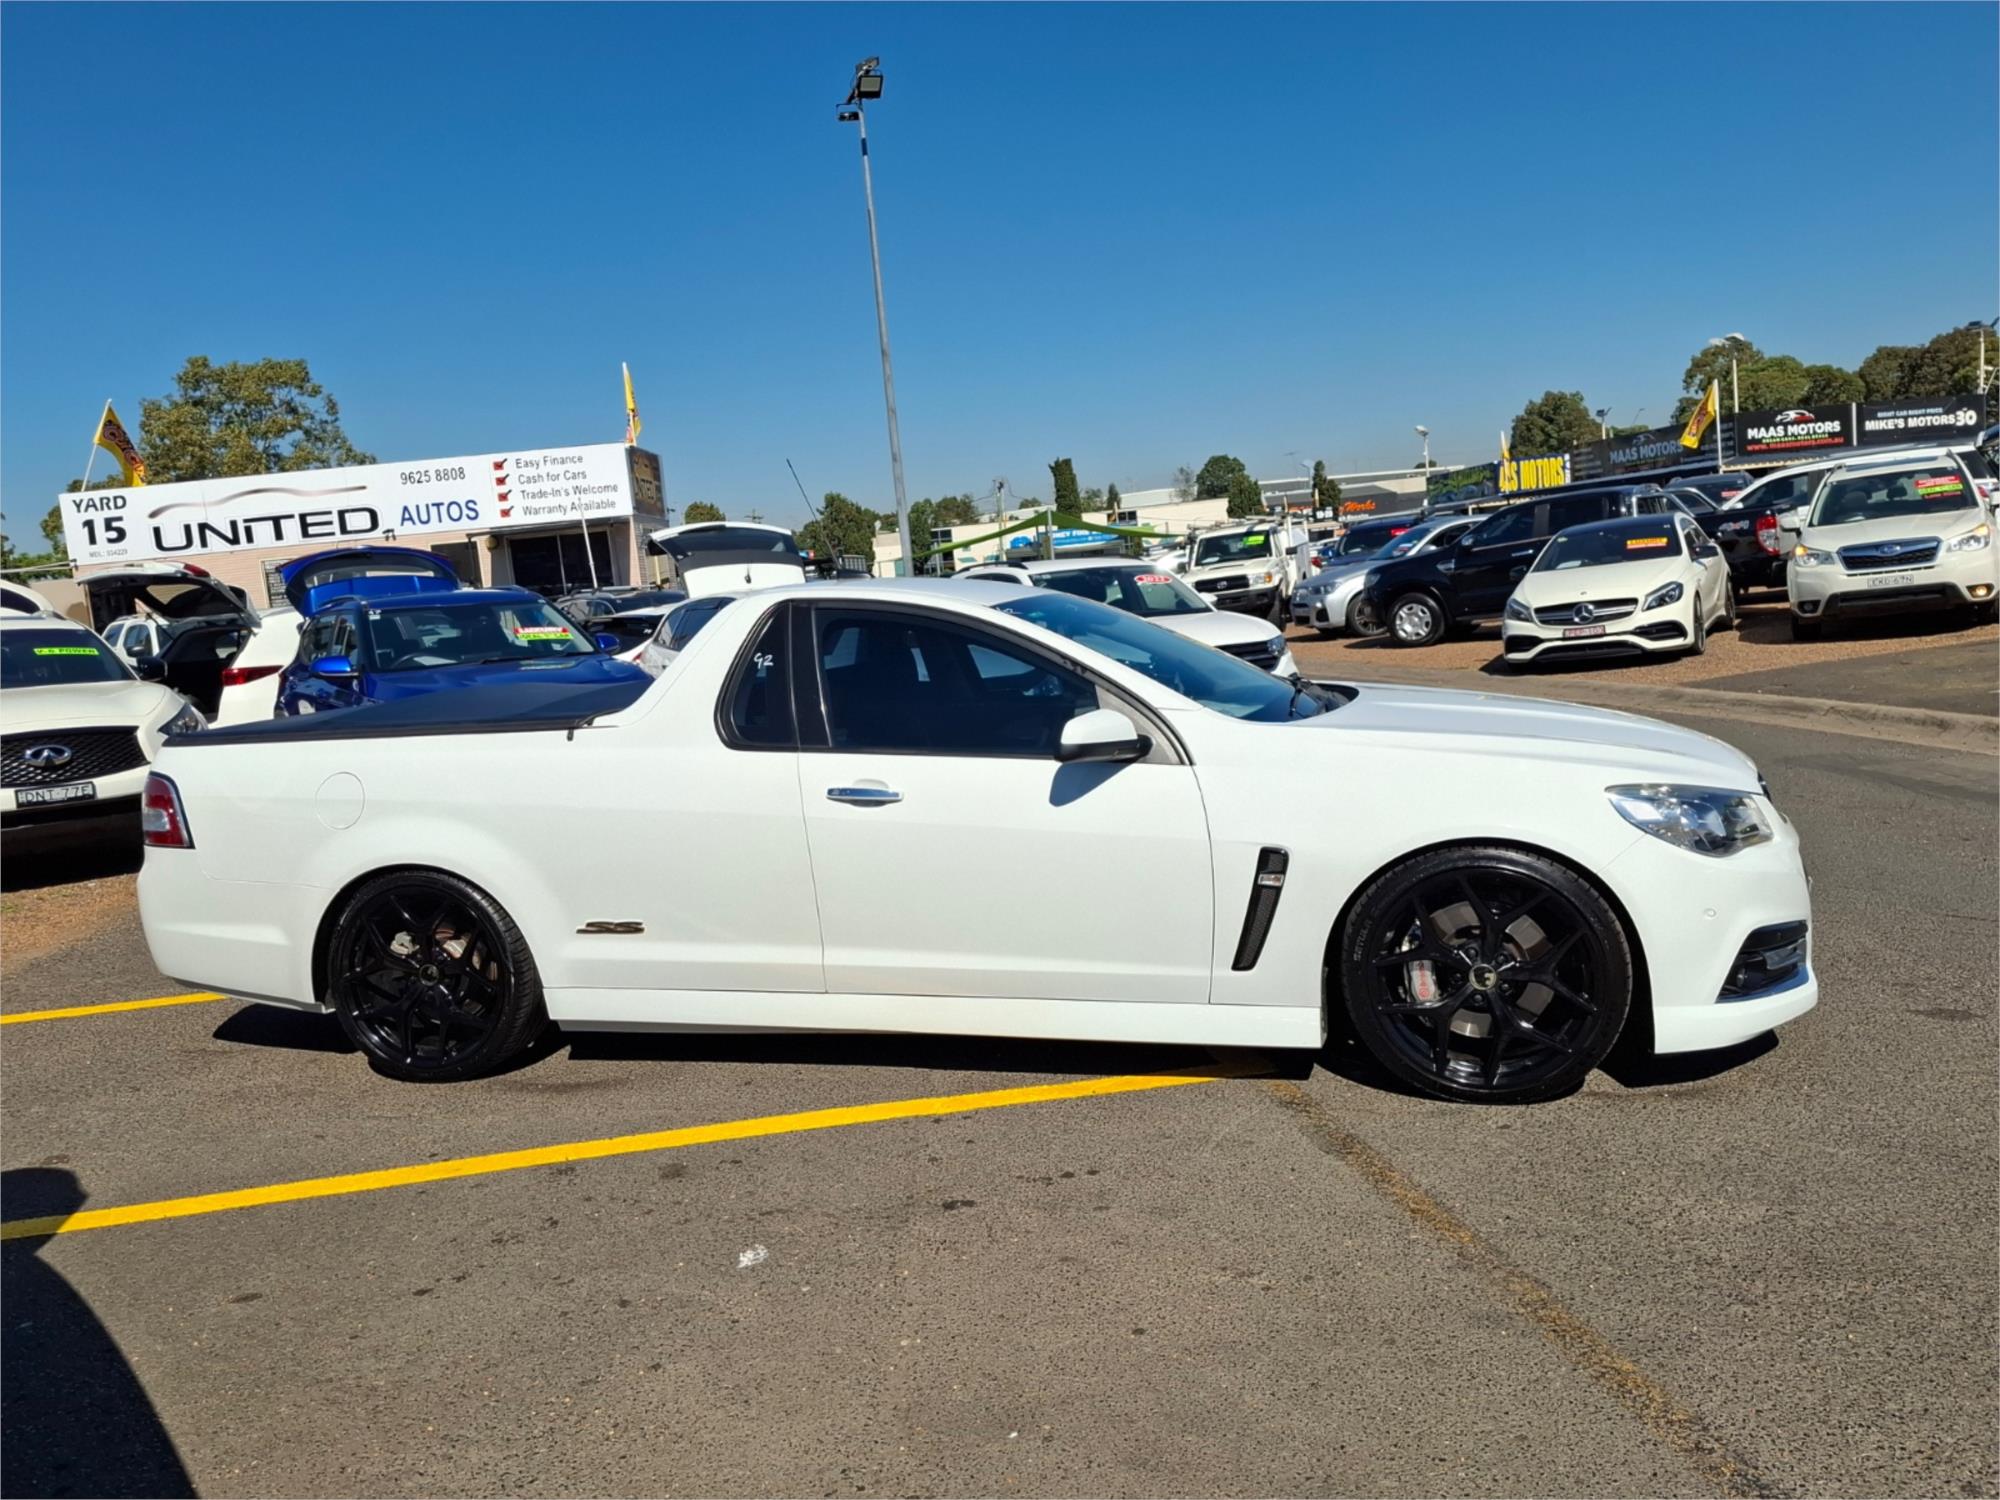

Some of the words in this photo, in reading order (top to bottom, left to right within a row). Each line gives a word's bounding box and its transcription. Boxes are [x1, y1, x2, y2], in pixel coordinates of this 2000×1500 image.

[1746, 425, 1786, 440] MAAS
[1787, 420, 1841, 436] MOTORS
[1864, 417, 1906, 431] MIKE'S
[1907, 413, 1956, 428] MOTORS
[1955, 409, 1978, 426] 30
[1609, 448, 1638, 464] MAAS
[1638, 439, 1684, 459] MOTORS
[515, 457, 541, 471] Easy
[542, 453, 584, 467] Finance
[400, 469, 432, 485] 9625
[435, 466, 466, 482] 8808
[518, 474, 545, 485] Cash
[546, 472, 558, 482] for
[559, 470, 587, 481] Cars
[1520, 456, 1565, 491] MOTORS
[520, 488, 571, 501] Trade-In's
[572, 483, 619, 496] Welcome
[72, 494, 127, 514] YARD
[522, 503, 568, 517] Warranty
[569, 498, 617, 512] Available
[81, 515, 127, 546] 15
[152, 506, 380, 553] UNITED
[400, 498, 480, 527] AUTOS
